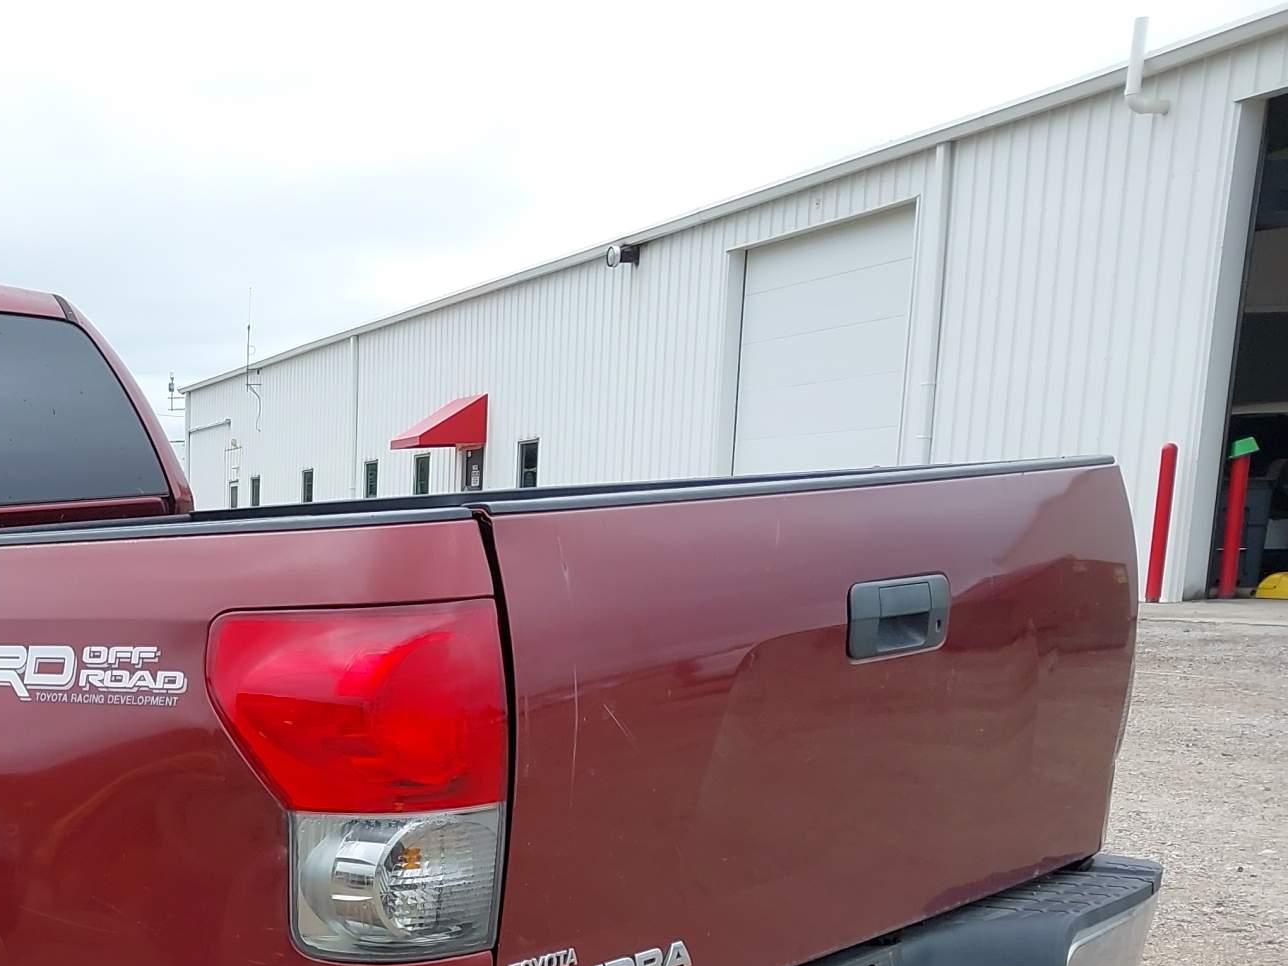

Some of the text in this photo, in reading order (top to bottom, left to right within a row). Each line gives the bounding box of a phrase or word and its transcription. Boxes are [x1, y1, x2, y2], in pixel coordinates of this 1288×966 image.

[81, 645, 161, 668] OFF
[78, 669, 188, 694] ROAD
[35, 691, 179, 707] TOYOTA RACING DEVELOPMENT
